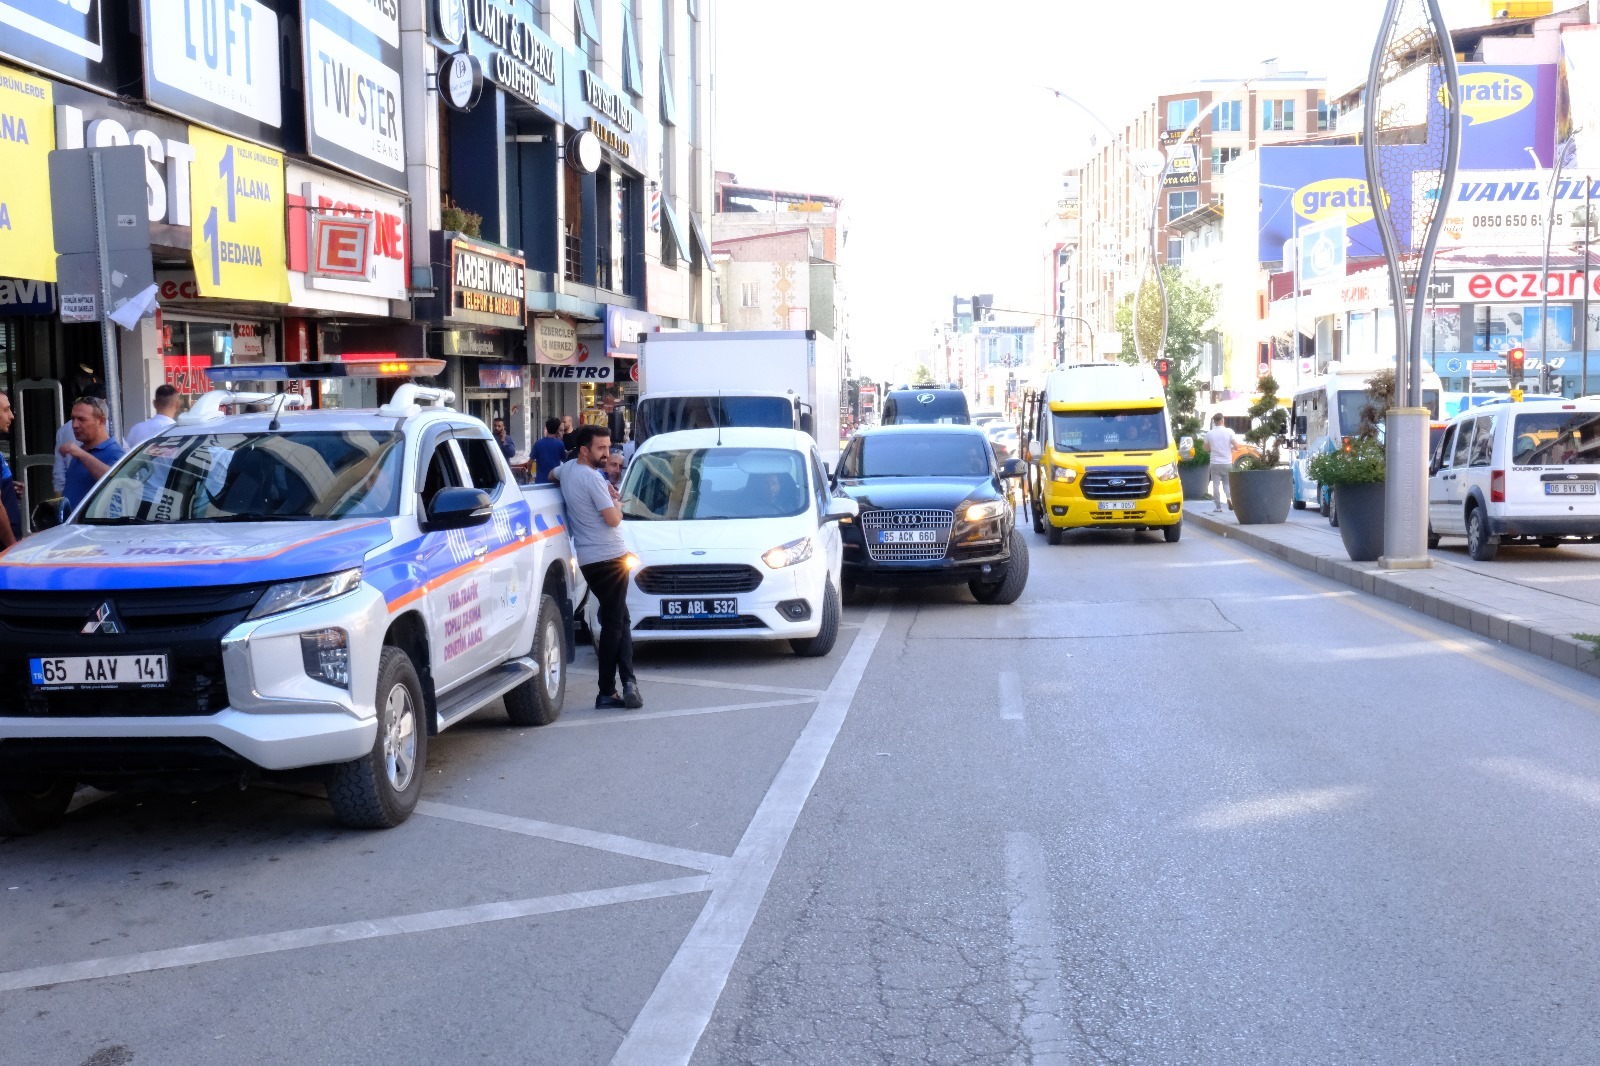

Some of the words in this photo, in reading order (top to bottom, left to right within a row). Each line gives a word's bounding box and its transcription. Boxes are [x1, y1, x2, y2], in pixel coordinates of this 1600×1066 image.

[524, 22, 557, 86] DERYA
[496, 51, 542, 105] COIFFEUR
[318, 49, 398, 142] TWISTER
[0, 113, 29, 145] NA
[371, 139, 399, 161] JEANS
[218, 144, 237, 223] 1
[236, 176, 271, 202] ALANA
[1472, 215, 1502, 227] 0850
[1505, 214, 1527, 226] 650
[203, 206, 221, 287] 1
[220, 240, 263, 267] BEDAVA
[456, 252, 491, 292] ARDEN
[548, 366, 611, 379] METRO
[1550, 484, 1560, 493] 06
[1563, 484, 1577, 493] BVK
[1580, 484, 1594, 493] 999
[884, 532, 894, 541] 65
[899, 532, 914, 541] ACK
[919, 531, 935, 541] 660
[668, 601, 682, 614] 65
[687, 600, 708, 614] ABL
[713, 600, 735, 614] 532
[33, 672, 44, 680] TR
[43, 659, 67, 682] 65
[85, 658, 118, 681] AAV
[135, 657, 165, 680] 141
